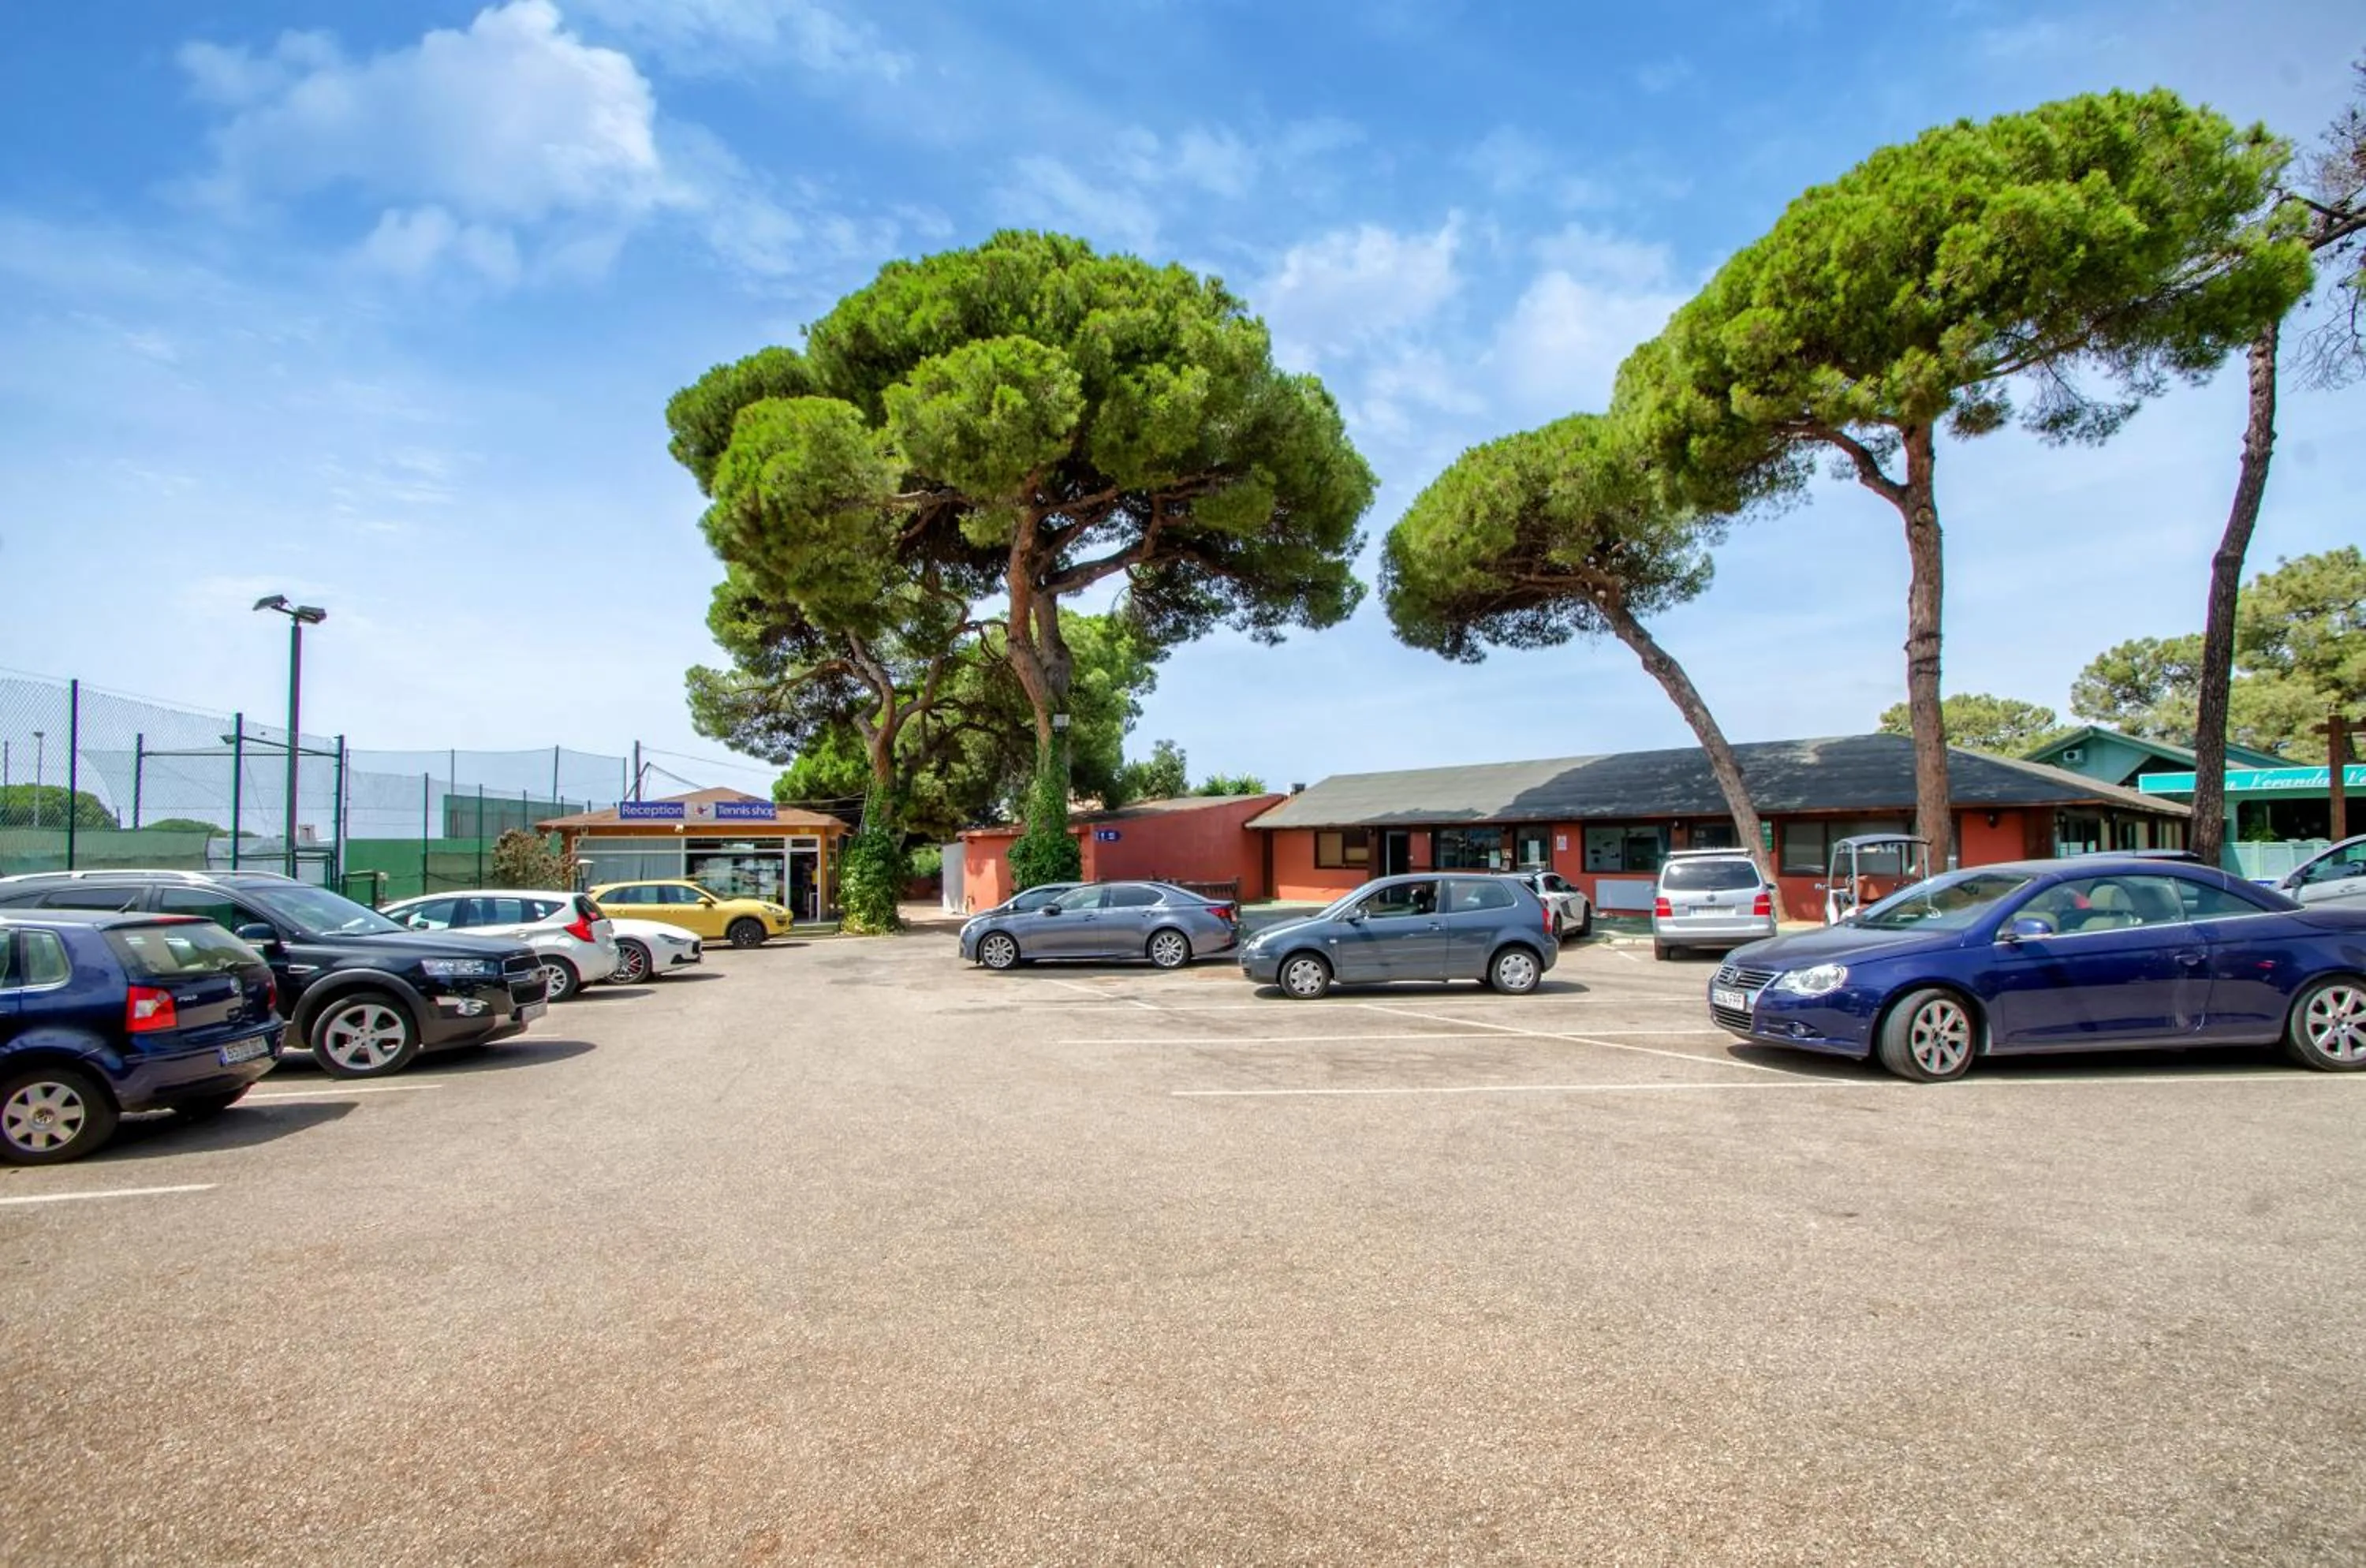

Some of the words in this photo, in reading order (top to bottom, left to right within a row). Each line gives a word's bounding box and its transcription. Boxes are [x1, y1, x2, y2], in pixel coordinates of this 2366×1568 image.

[622, 805, 683, 818] Reception
[718, 805, 750, 816] Tennis
[752, 805, 777, 818] shop
